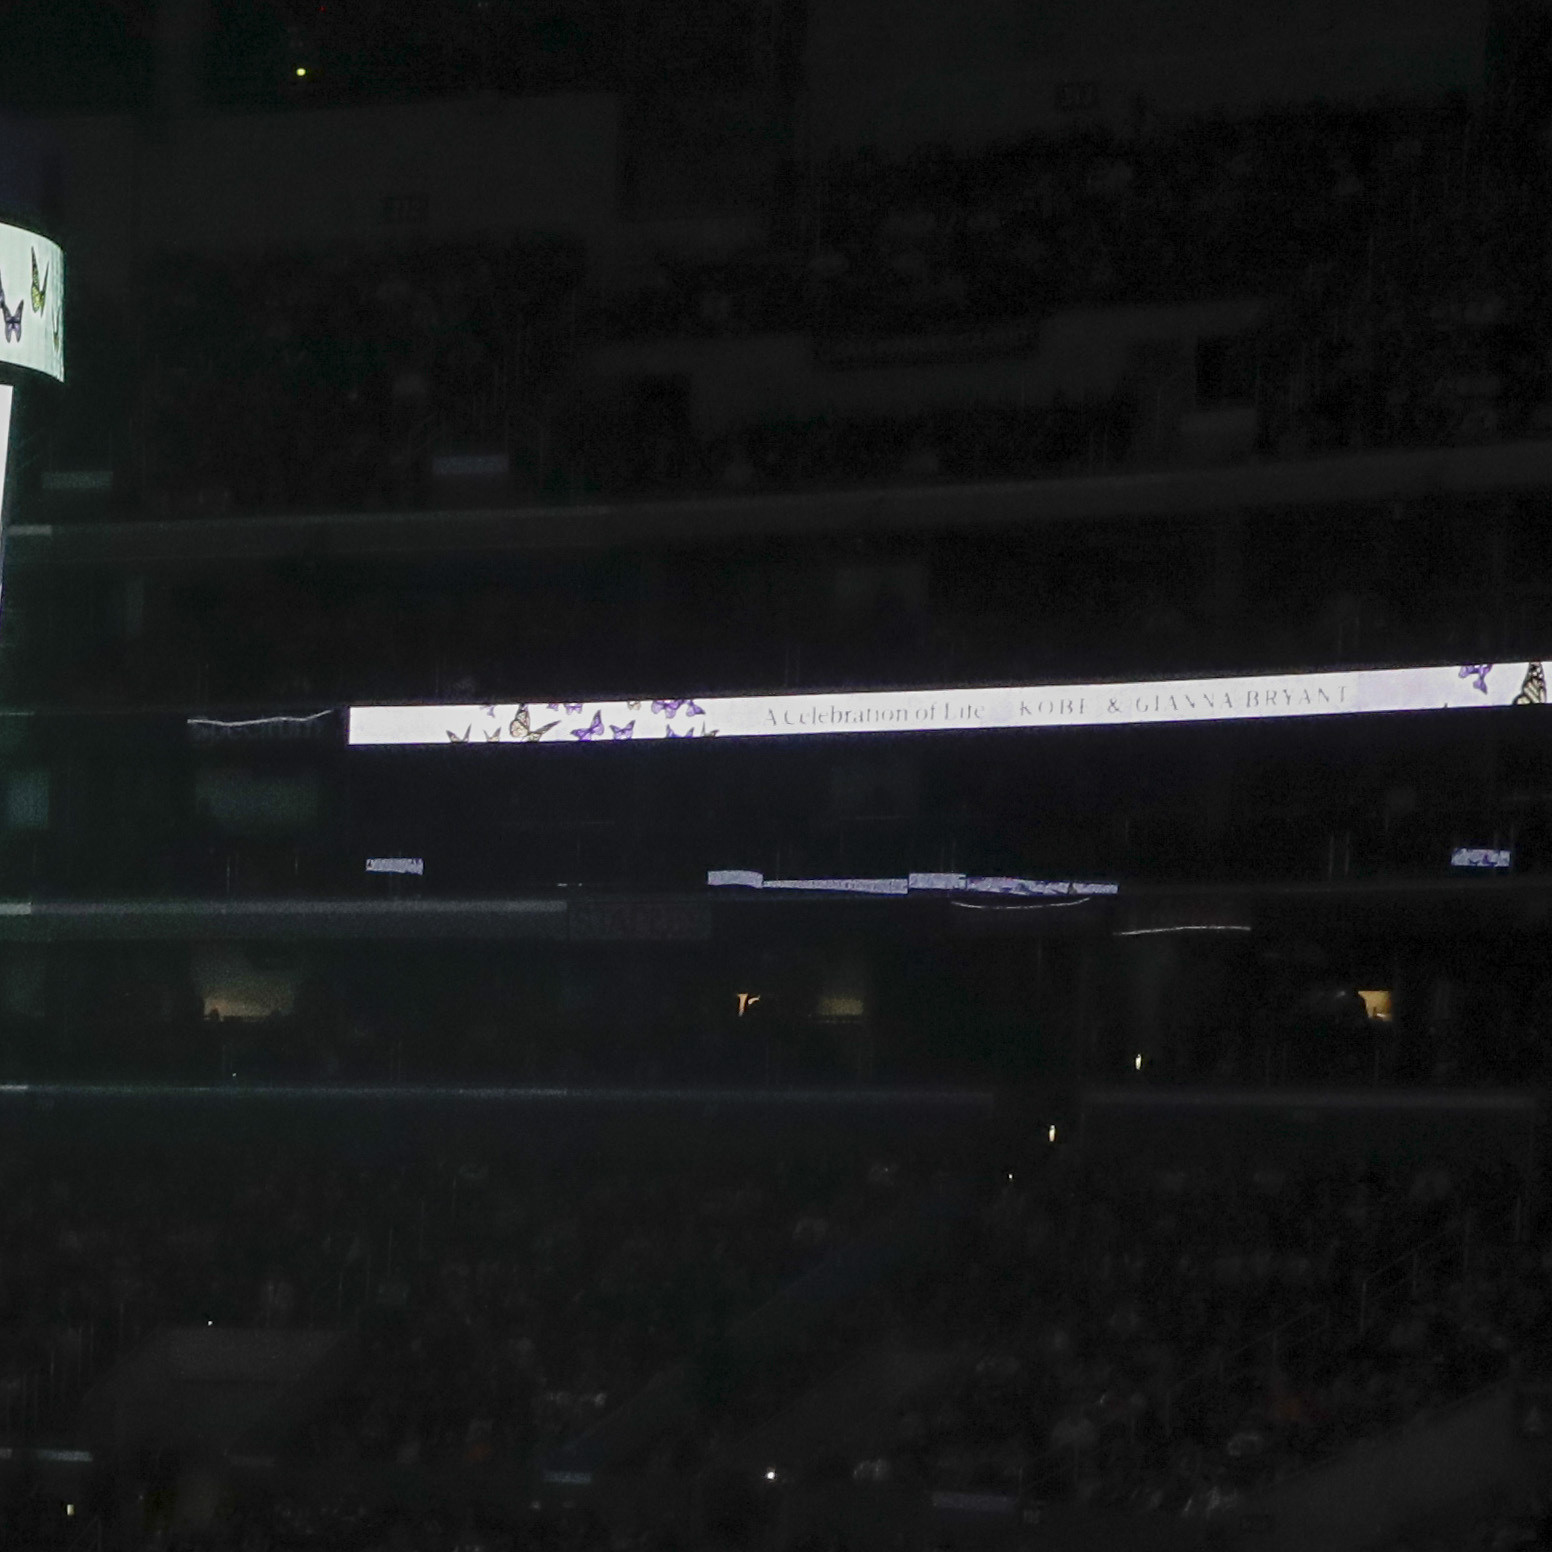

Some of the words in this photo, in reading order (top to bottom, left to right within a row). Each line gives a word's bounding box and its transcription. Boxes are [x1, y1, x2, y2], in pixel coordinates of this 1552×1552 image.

[783, 701, 908, 726] Celebration
[916, 701, 937, 722] of
[1020, 697, 1090, 717] KOBE
[1107, 697, 1123, 713] &
[1136, 690, 1234, 714] GIANNA
[1245, 685, 1349, 710] BRYANT
